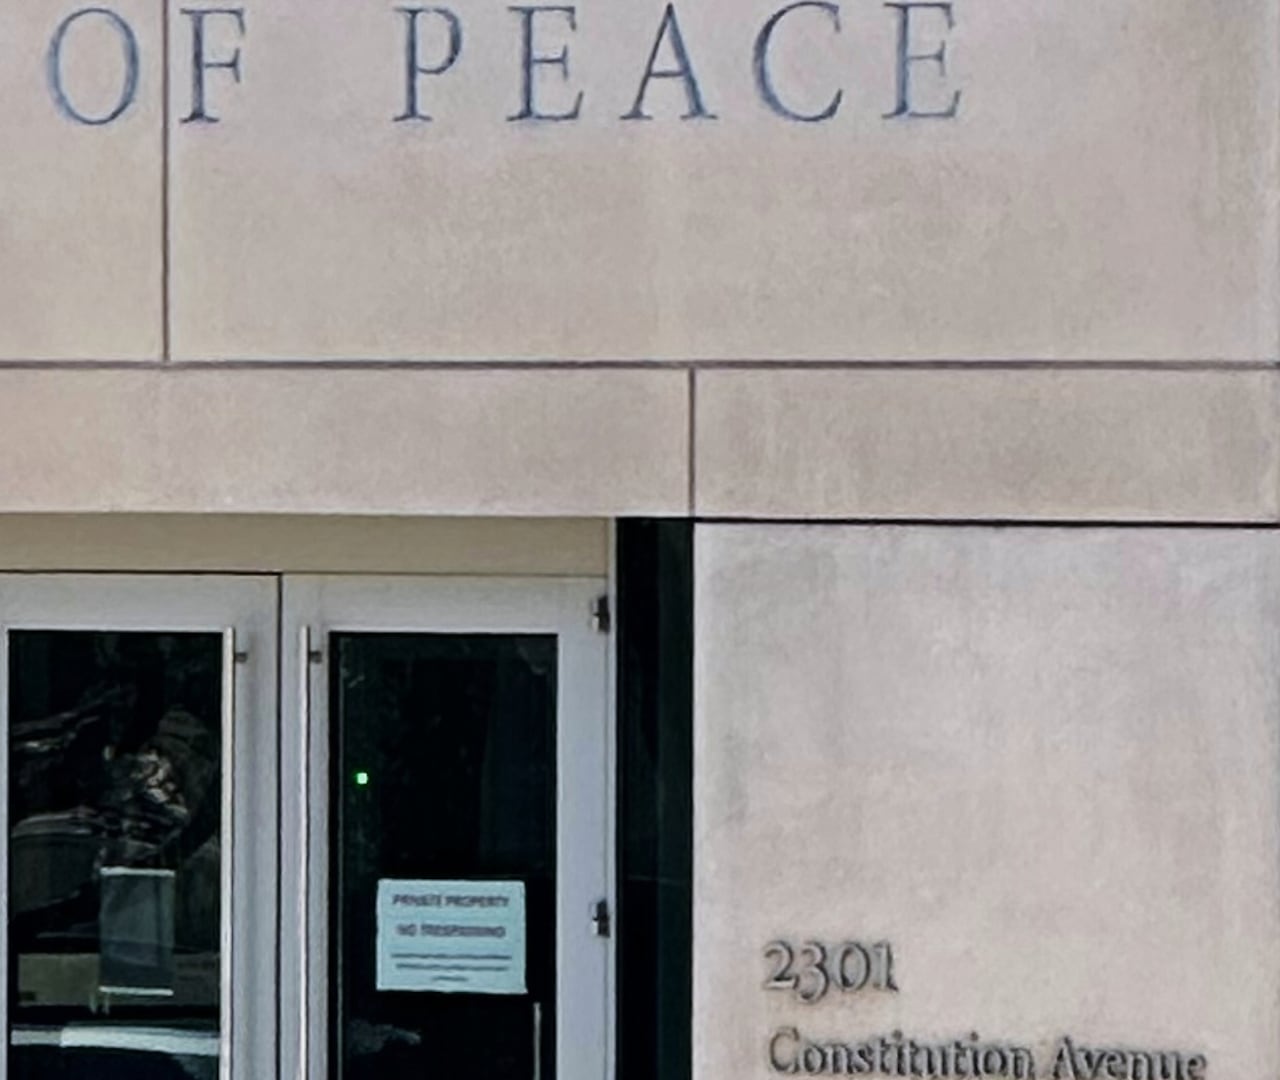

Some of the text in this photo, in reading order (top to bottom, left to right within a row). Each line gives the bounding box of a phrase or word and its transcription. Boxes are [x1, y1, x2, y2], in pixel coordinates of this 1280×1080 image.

[45, 5, 245, 126] OF
[391, 1, 963, 124] PEACE
[763, 938, 899, 1001] 2301
